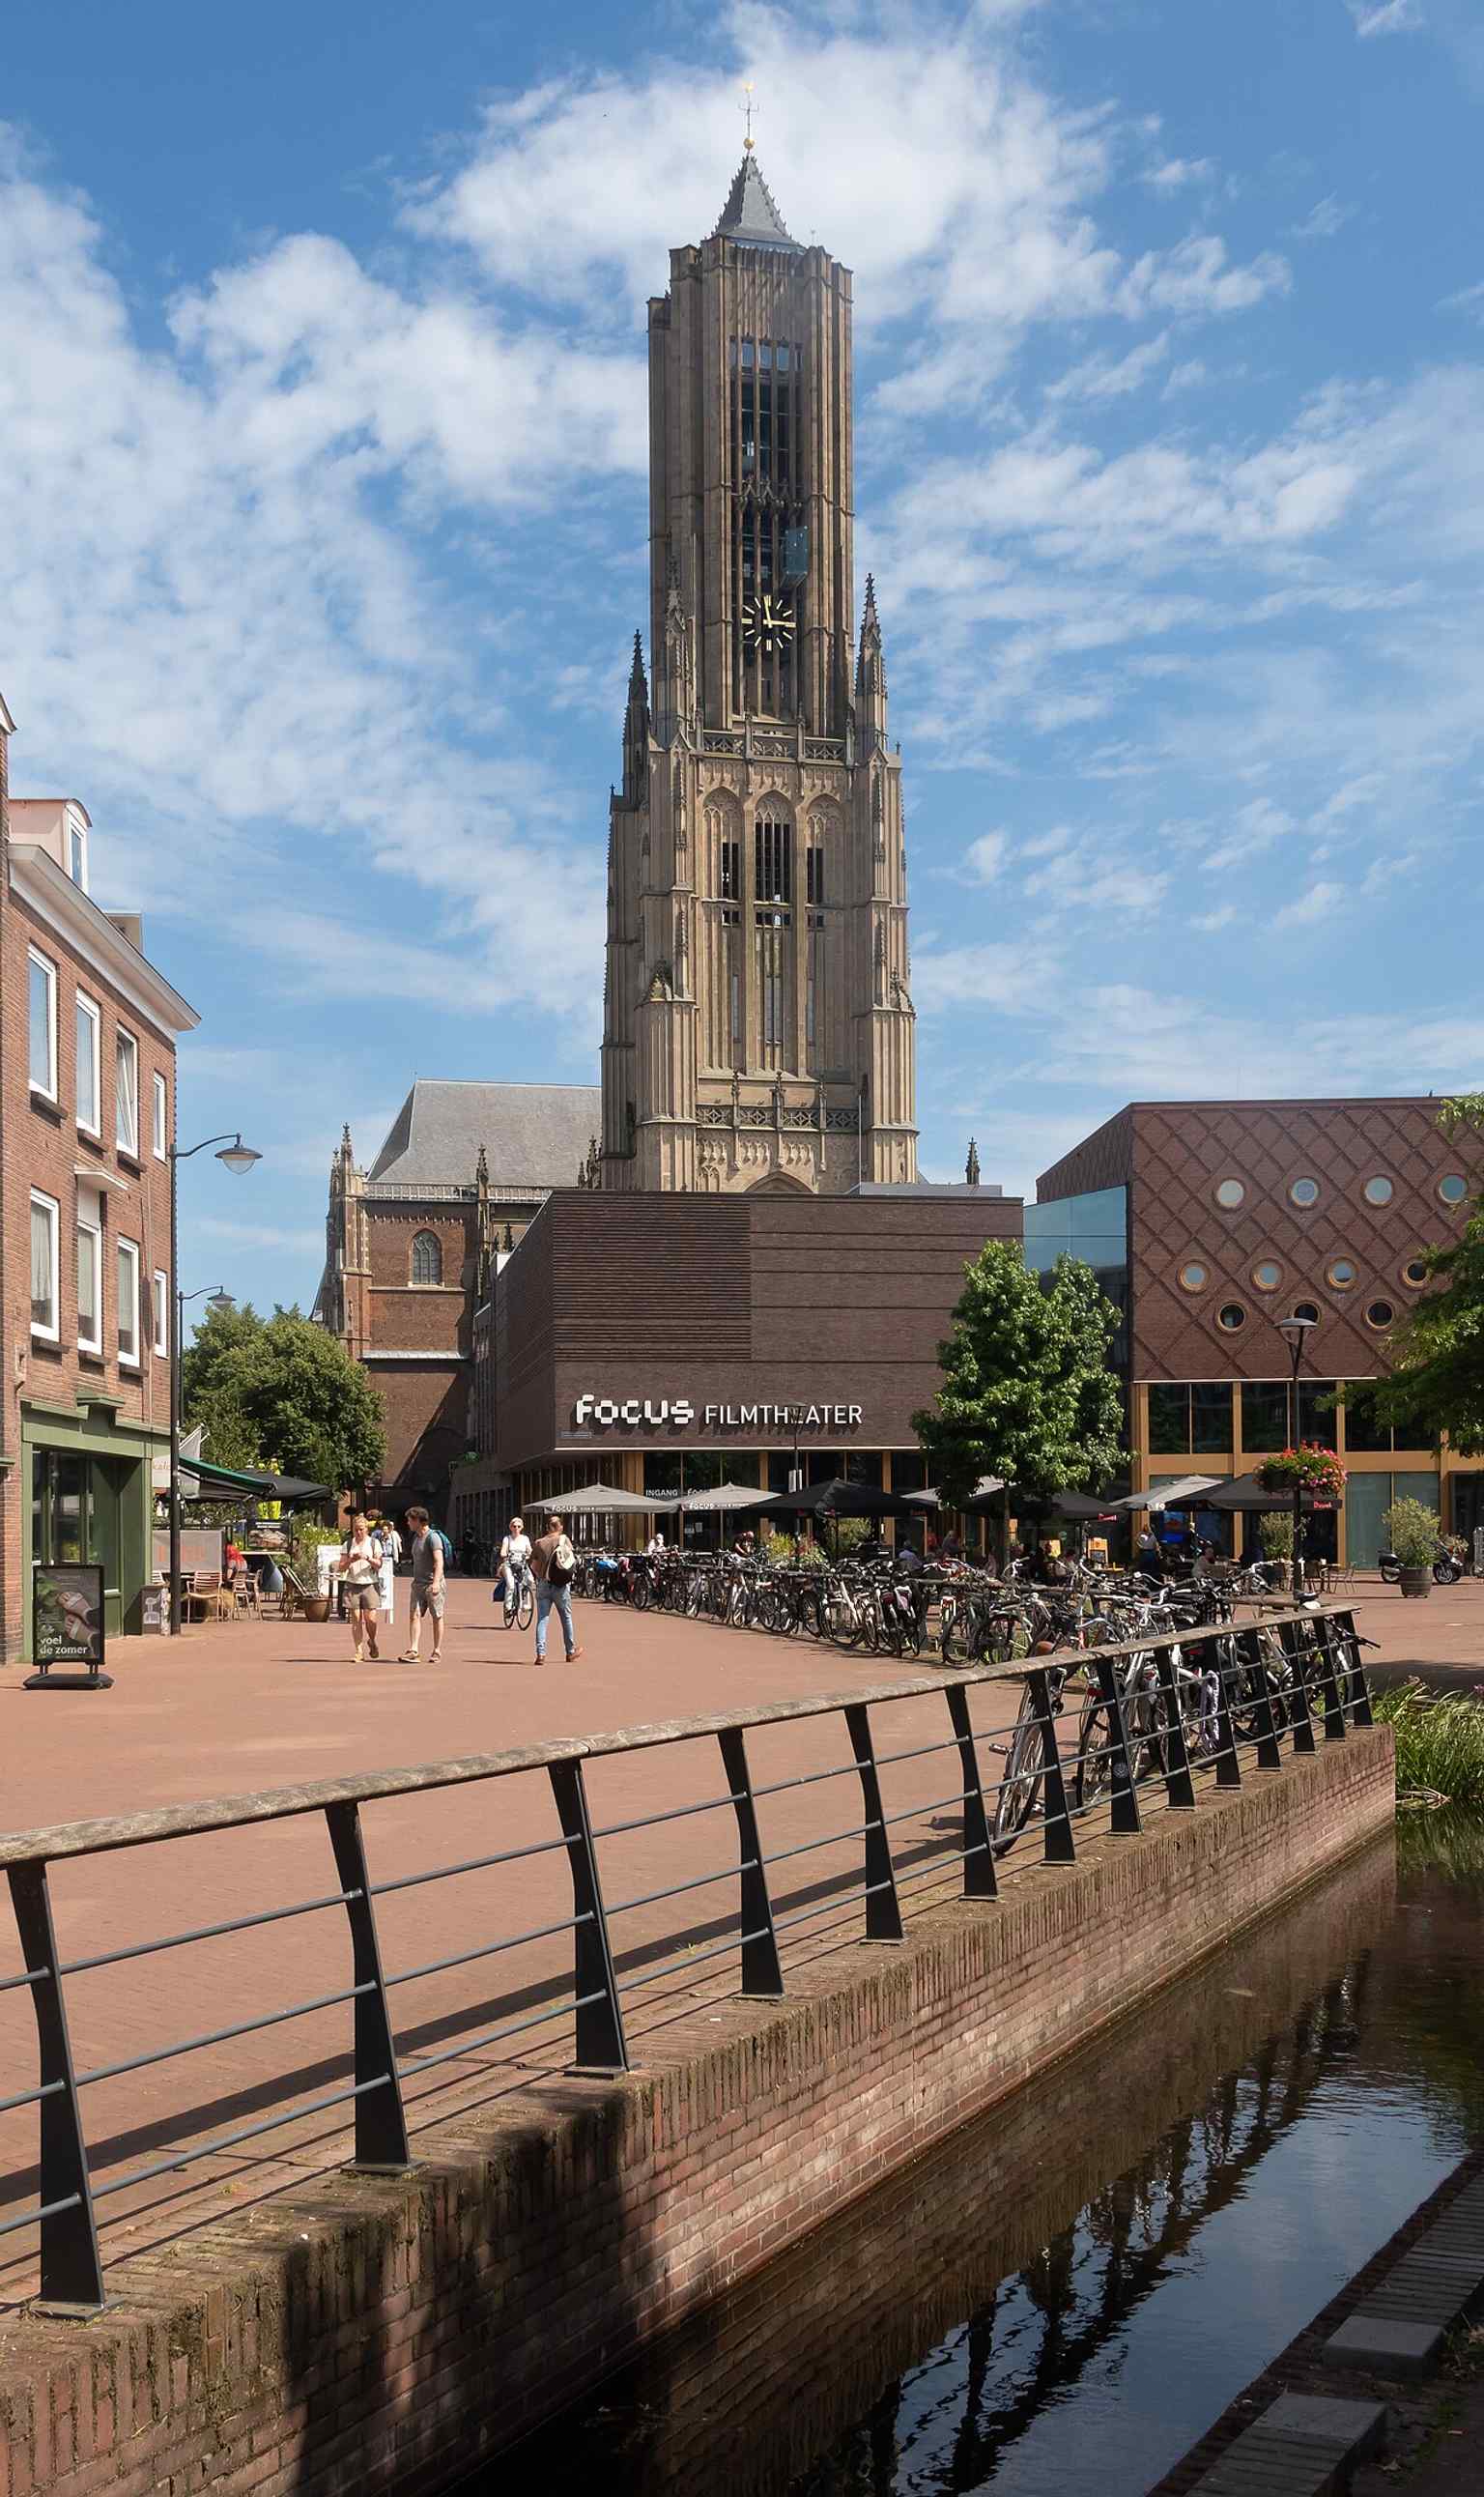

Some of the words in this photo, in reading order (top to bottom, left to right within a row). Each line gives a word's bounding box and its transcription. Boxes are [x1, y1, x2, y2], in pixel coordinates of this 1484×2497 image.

[40, 1635, 62, 1645] voel
[40, 1645, 53, 1654] de
[55, 1646, 88, 1654] zomer
